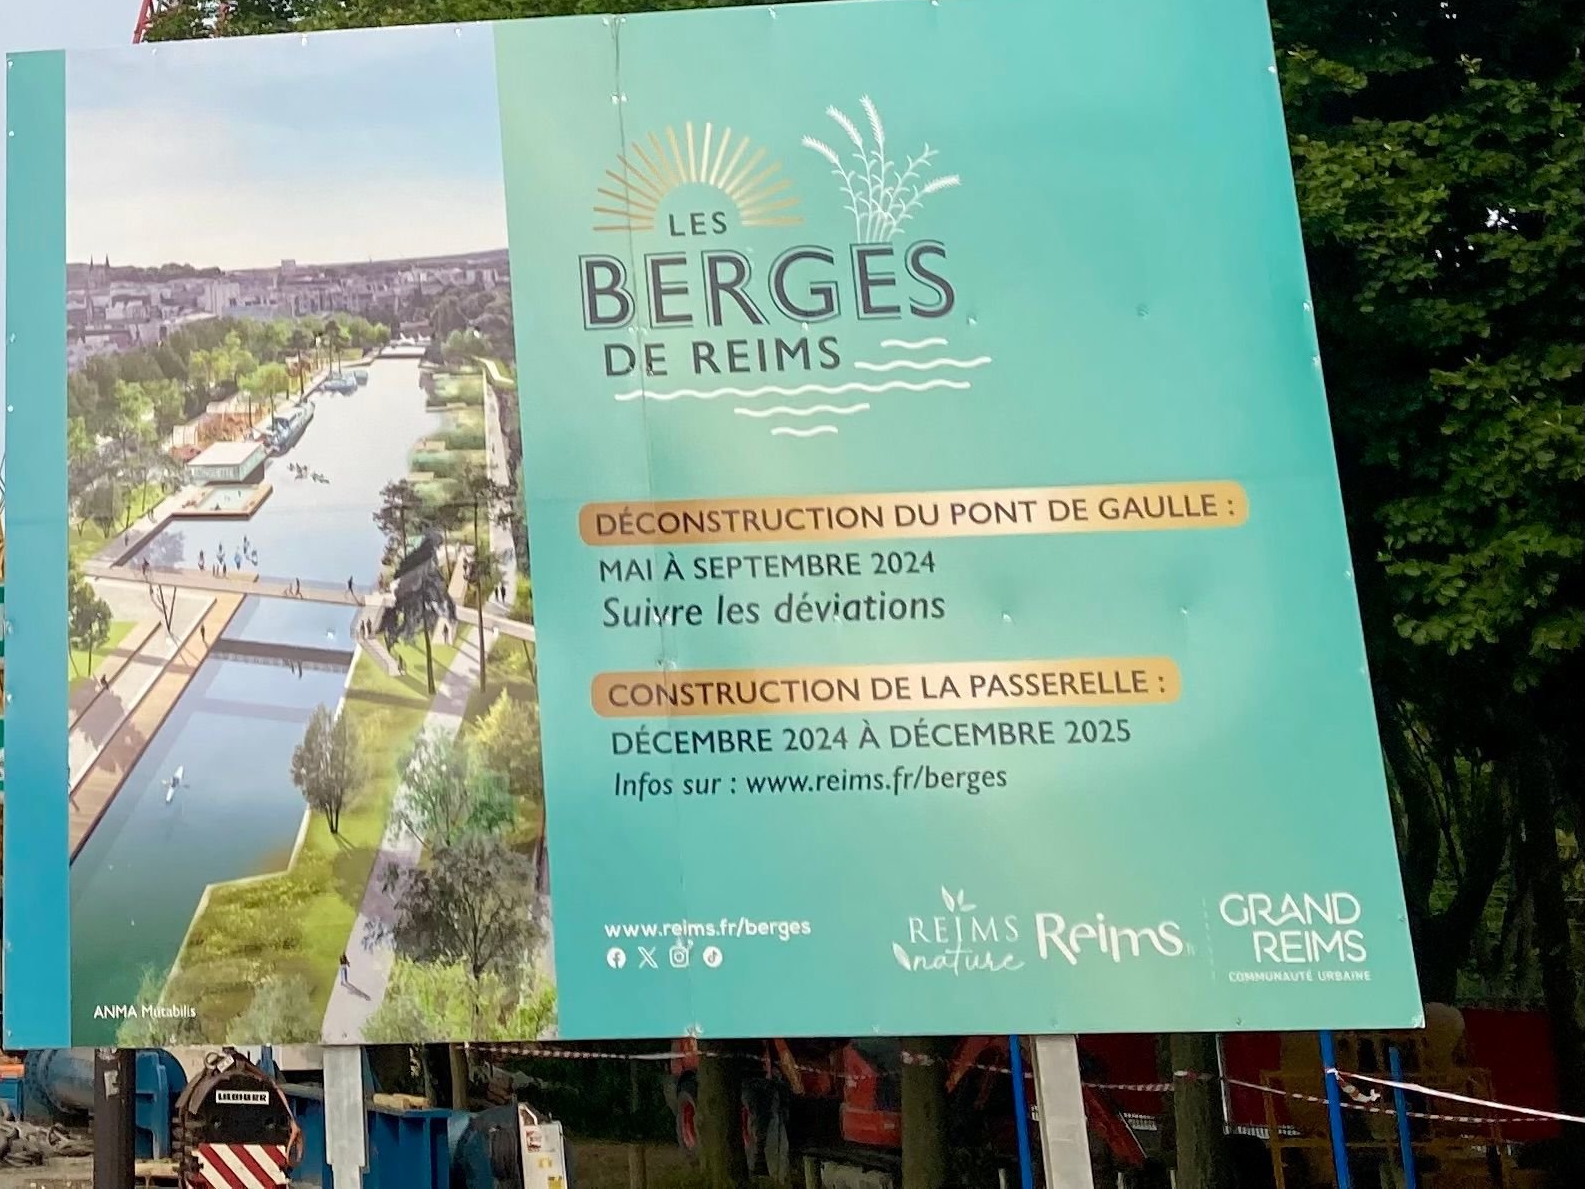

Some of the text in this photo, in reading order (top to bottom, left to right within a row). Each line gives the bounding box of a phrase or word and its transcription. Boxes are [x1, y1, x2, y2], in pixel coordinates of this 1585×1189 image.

[668, 211, 728, 236] LES
[578, 239, 955, 331] BERGES
[604, 336, 842, 377] DE REIMS
[597, 505, 884, 535] DÉCONSTRUCTION
[894, 503, 940, 528] DU
[951, 500, 1036, 525] PONT
[1049, 497, 1087, 521] DE
[1097, 493, 1217, 520] GAULLE
[599, 550, 935, 582] MAI À SEPTEMBRE 2024
[603, 591, 945, 628] Suivre les déviations
[609, 678, 860, 706] CONSTRUCTION
[871, 676, 911, 701] DE
[922, 673, 961, 700] LA
[970, 669, 1148, 698] PASSERELLE
[612, 717, 1131, 755] DÉCEMBRE 2024 À DÉCEMBRE 2025
[614, 771, 674, 801] Infos
[683, 775, 722, 796] sur
[746, 768, 1007, 795] www.reims.fr/berges
[1219, 892, 1361, 927] GRAND
[605, 917, 811, 941] www.reims.fr/berges
[909, 915, 1018, 943] REIMS
[1036, 912, 1185, 965] Reims
[1253, 929, 1367, 964] REIMS
[913, 946, 1025, 976] nature
[1229, 967, 1371, 982] COMMUNAUTÉ URBAINE
[94, 1004, 196, 1019] ANMA Mutabilis
